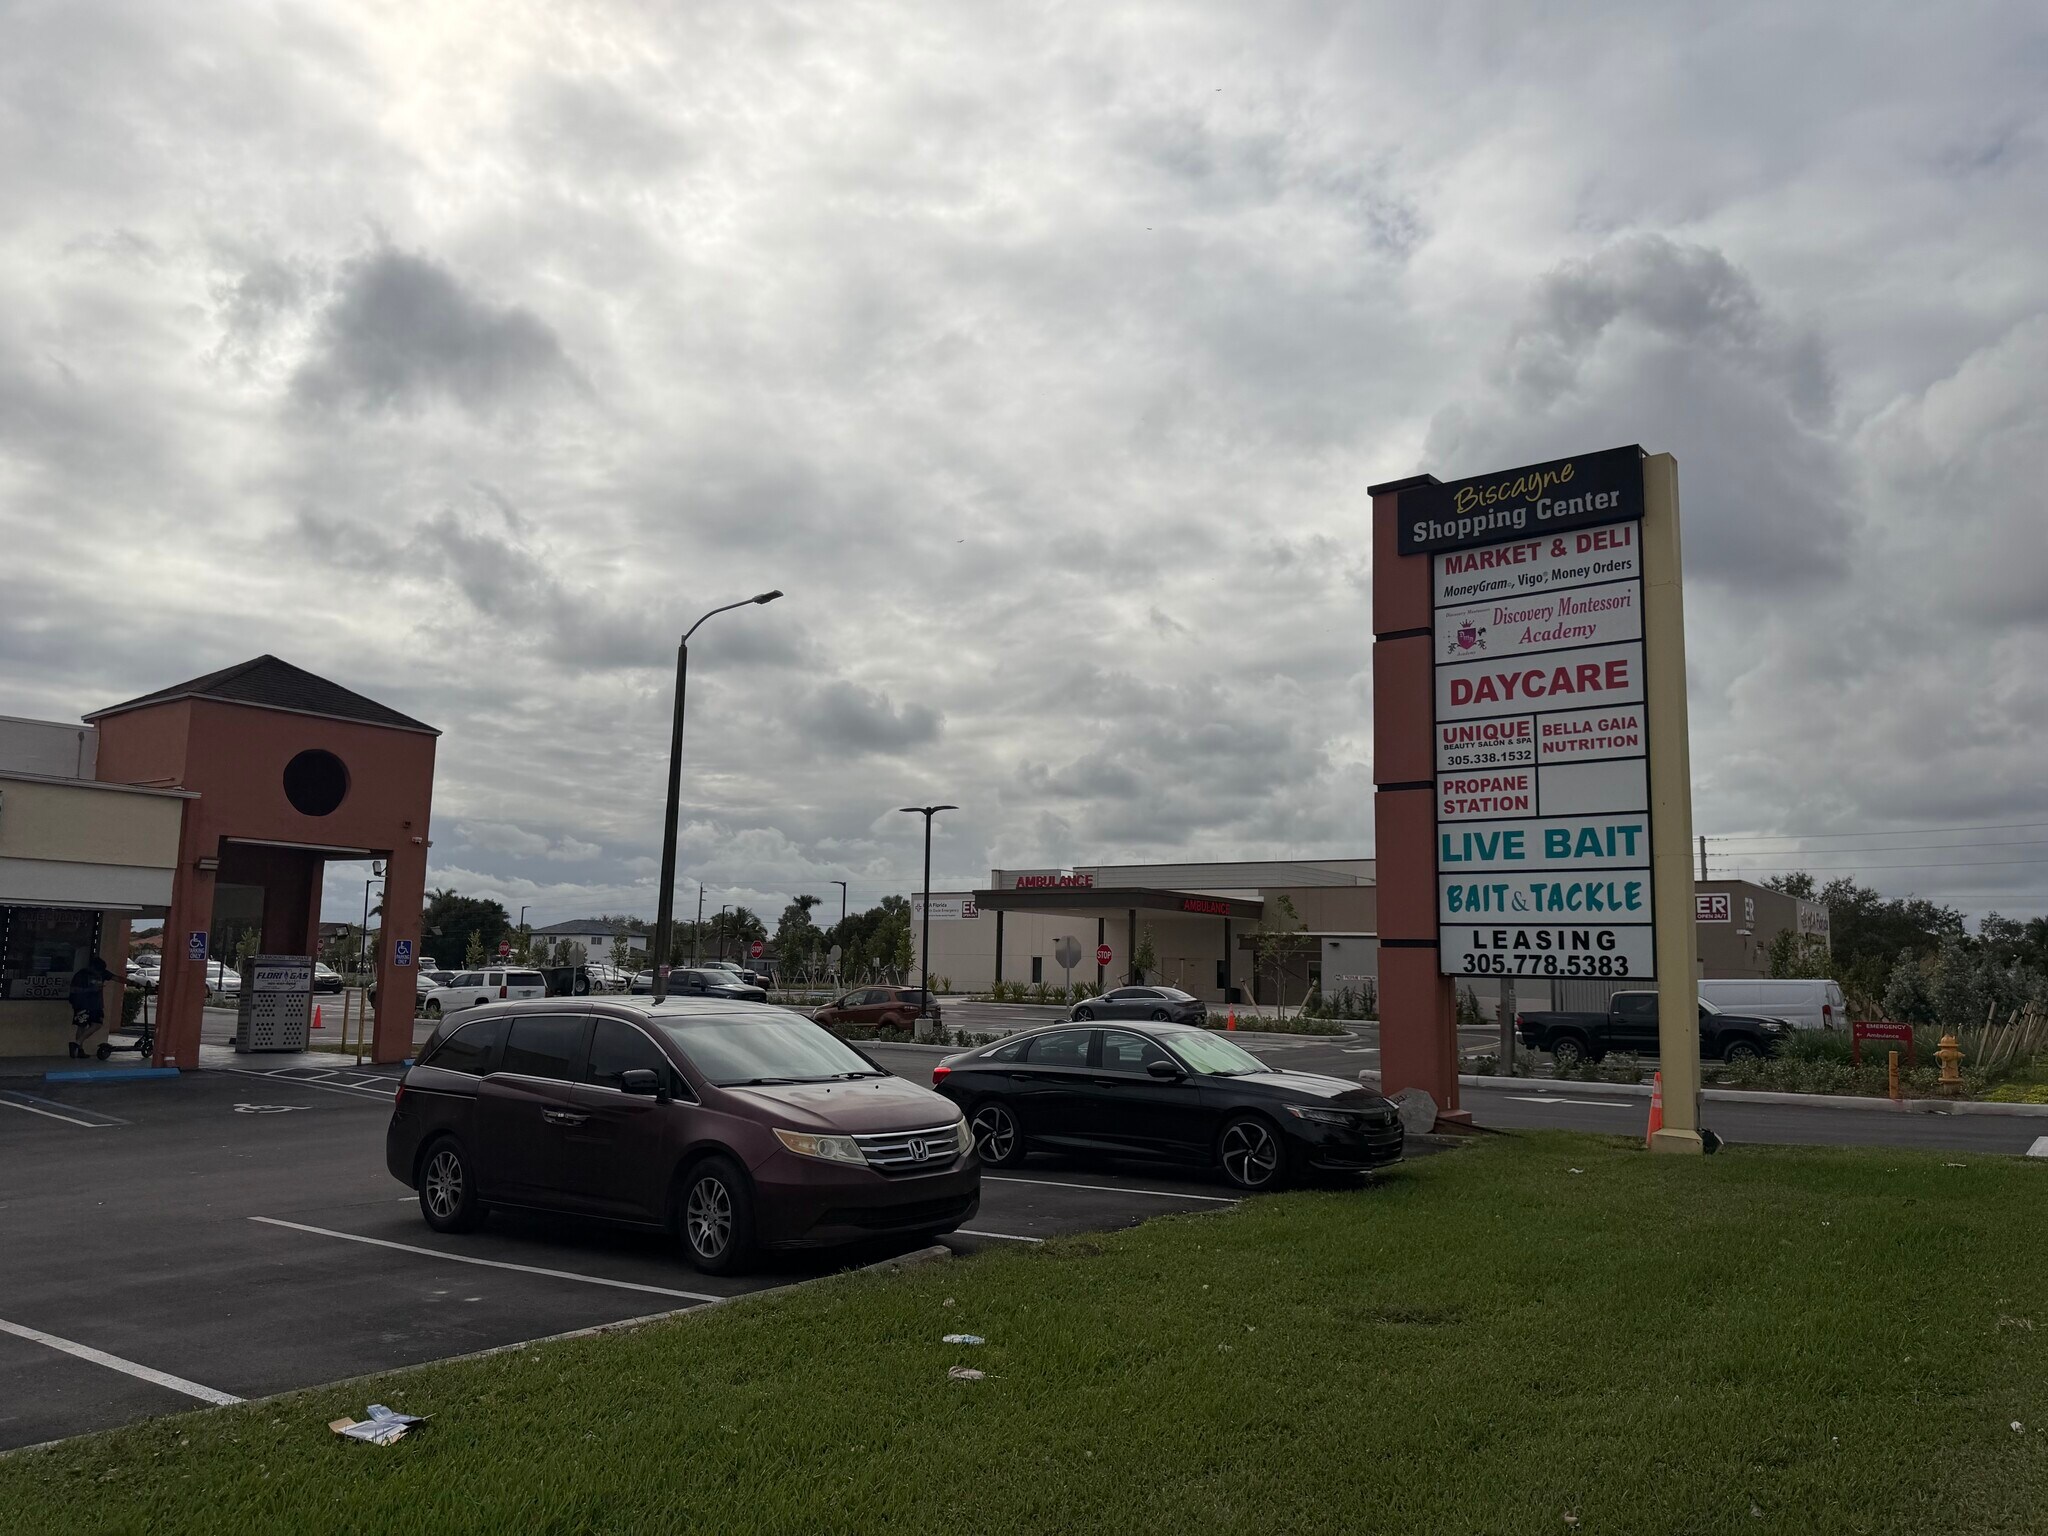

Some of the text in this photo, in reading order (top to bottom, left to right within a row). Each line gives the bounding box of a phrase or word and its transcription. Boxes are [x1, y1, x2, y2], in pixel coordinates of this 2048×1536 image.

[1454, 463, 1575, 514] Biscayne
[1413, 490, 1620, 542] Shopping Center
[1445, 527, 1631, 576] MARKET & DELI
[1552, 566, 1590, 580] Money
[1593, 560, 1632, 574] Orders
[1493, 588, 1631, 626] Discovery Montessori
[1518, 622, 1596, 644] Academy
[1450, 660, 1629, 706] DAYCARE
[1443, 721, 1530, 744] UNIQUE
[1542, 716, 1638, 737] BELLA GAIA
[1444, 742, 1476, 750] BEAUTY
[1478, 739, 1504, 748] SALON
[1542, 734, 1638, 754] NUTRITION
[1448, 750, 1532, 766] 305.338.1532
[1444, 776, 1528, 795] PROPANE
[1444, 796, 1528, 814] STATION
[1442, 825, 1642, 862] LIVE BAIT
[1016, 874, 1094, 888] AMBULANCE
[1446, 882, 1642, 912] BAIT & TACKLE
[1696, 897, 1726, 914] ER
[1183, 899, 1231, 916] AMBULANCE
[1473, 930, 1616, 950] LEASING
[1098, 951, 1111, 959] STOP
[1463, 954, 1628, 976] 305.778.5383
[26, 988, 59, 996] SODA
